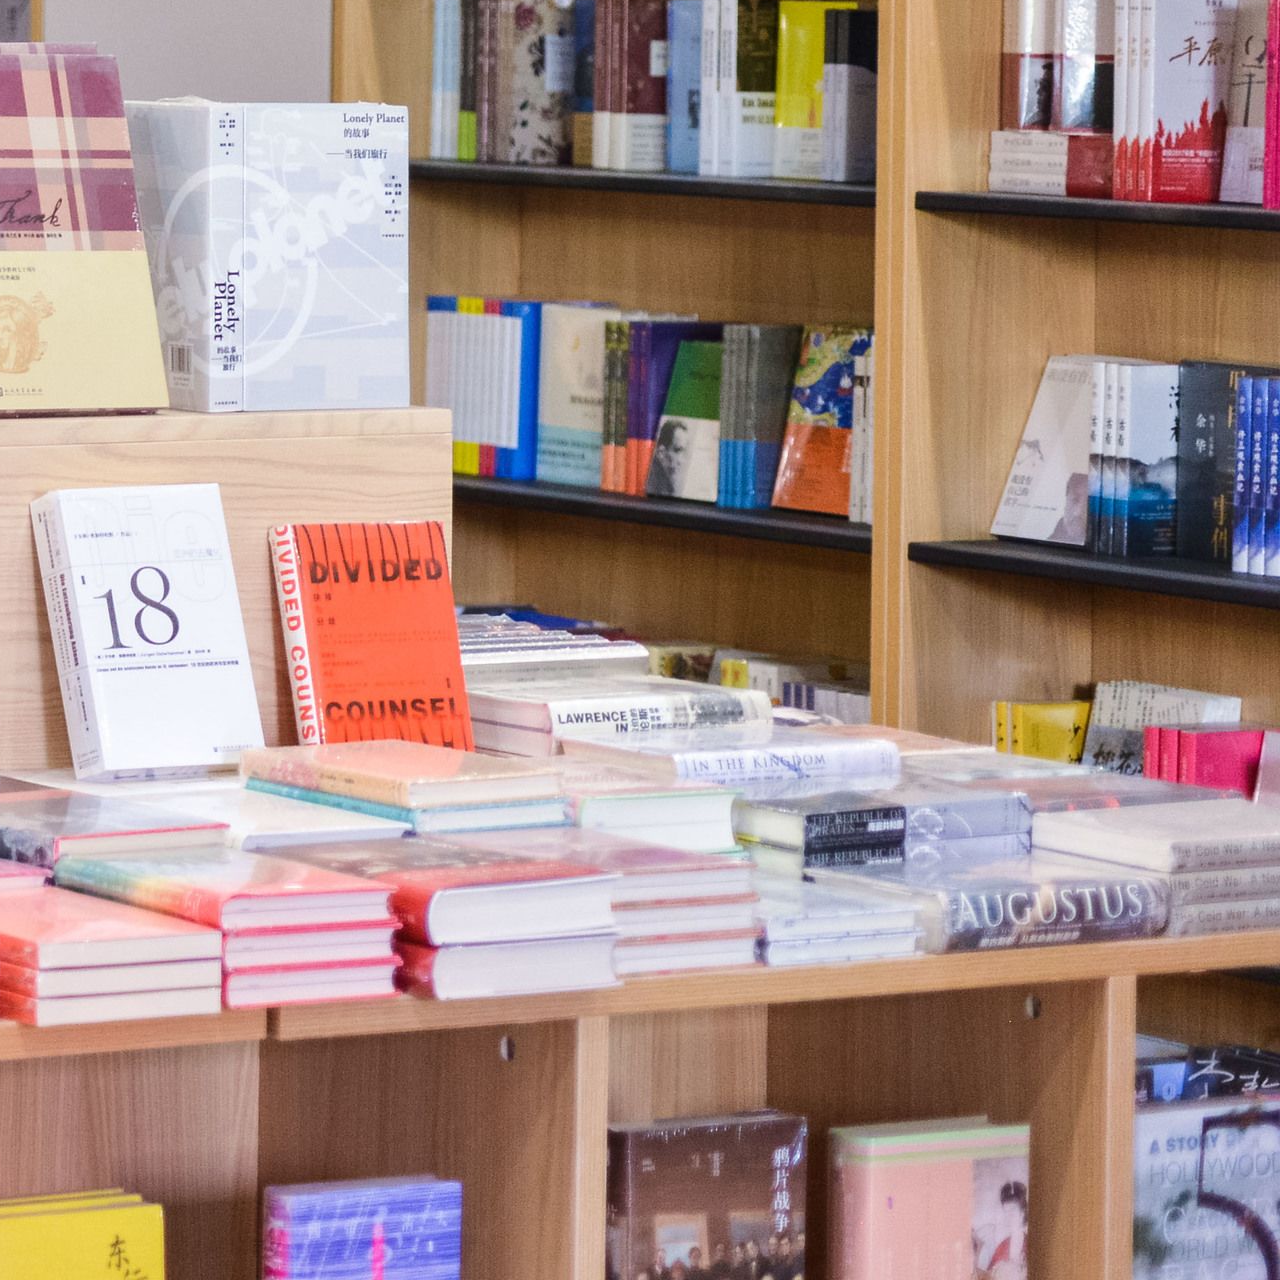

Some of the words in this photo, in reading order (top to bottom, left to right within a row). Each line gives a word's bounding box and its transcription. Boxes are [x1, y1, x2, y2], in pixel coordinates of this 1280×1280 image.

[342, 112, 374, 126] Lonely
[376, 112, 405, 124] Planet
[343, 127, 371, 139] 的故事
[213, 281, 228, 342] Planet
[226, 269, 241, 335] Lonely
[1195, 413, 1208, 455] 余华
[309, 558, 444, 585] DIVIDED
[92, 565, 181, 650] 18
[291, 643, 320, 746] COUNS
[557, 710, 628, 725] LAWRENCE
[614, 723, 629, 733] IN
[692, 757, 710, 773] IN
[717, 756, 746, 771] THE
[752, 752, 827, 772] KINGDOM
[952, 881, 1145, 932] AUGUSTUS
[772, 1146, 791, 1235] 鸦片战争
